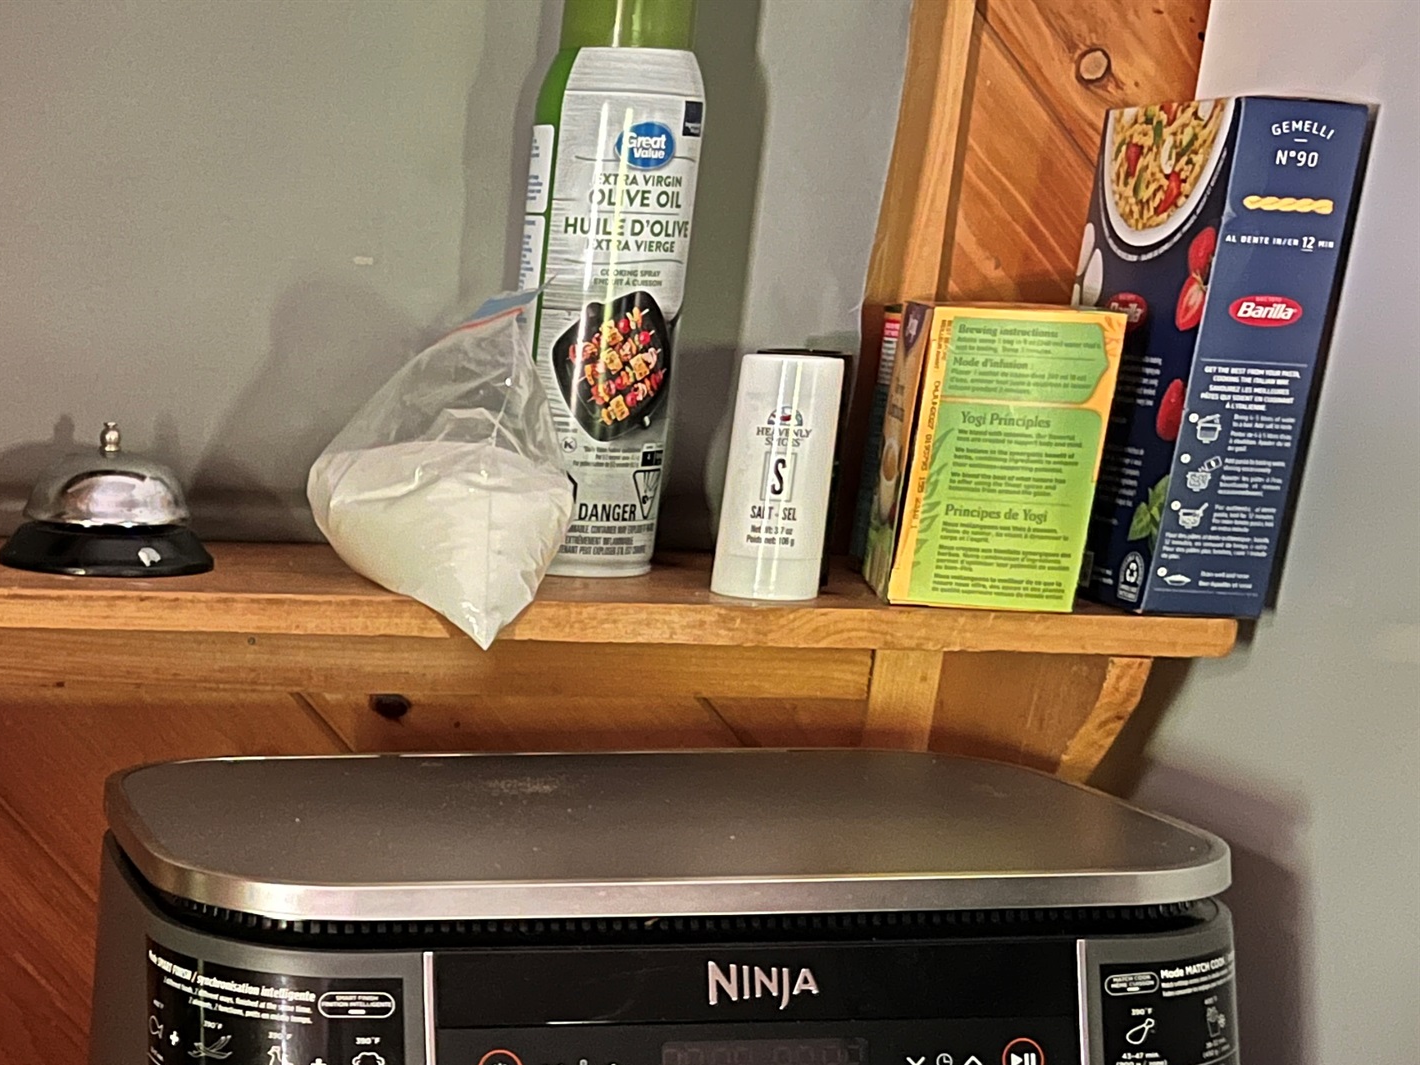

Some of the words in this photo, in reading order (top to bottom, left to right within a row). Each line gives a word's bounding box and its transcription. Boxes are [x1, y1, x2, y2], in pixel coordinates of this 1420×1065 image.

[1272, 120, 1334, 139] GEMELLI
[627, 131, 666, 149] Great
[633, 148, 665, 159] Value
[643, 175, 682, 187] VIRGIN
[589, 189, 651, 207] OLIVE
[657, 191, 681, 208] OIL
[564, 217, 625, 236] HUILE
[635, 240, 675, 252] VIERGE
[1241, 236, 1269, 244] DENTE
[1302, 236, 1315, 248] 12
[1237, 302, 1294, 320] Barilla
[958, 324, 997, 337] Brewing
[953, 356, 979, 367] Mode
[982, 358, 1028, 369] d'infusion
[961, 411, 986, 427] Yogi
[990, 413, 1051, 430] Principles
[771, 458, 786, 495] S
[578, 503, 636, 521] DANGER
[782, 507, 797, 521] SEL
[945, 504, 1001, 521] Principes
[1004, 508, 1019, 520] de
[1022, 509, 1048, 525] Yogi
[1160, 968, 1184, 979] Mode
[1185, 962, 1210, 975] MATCH
[708, 961, 819, 1010] NINJA
